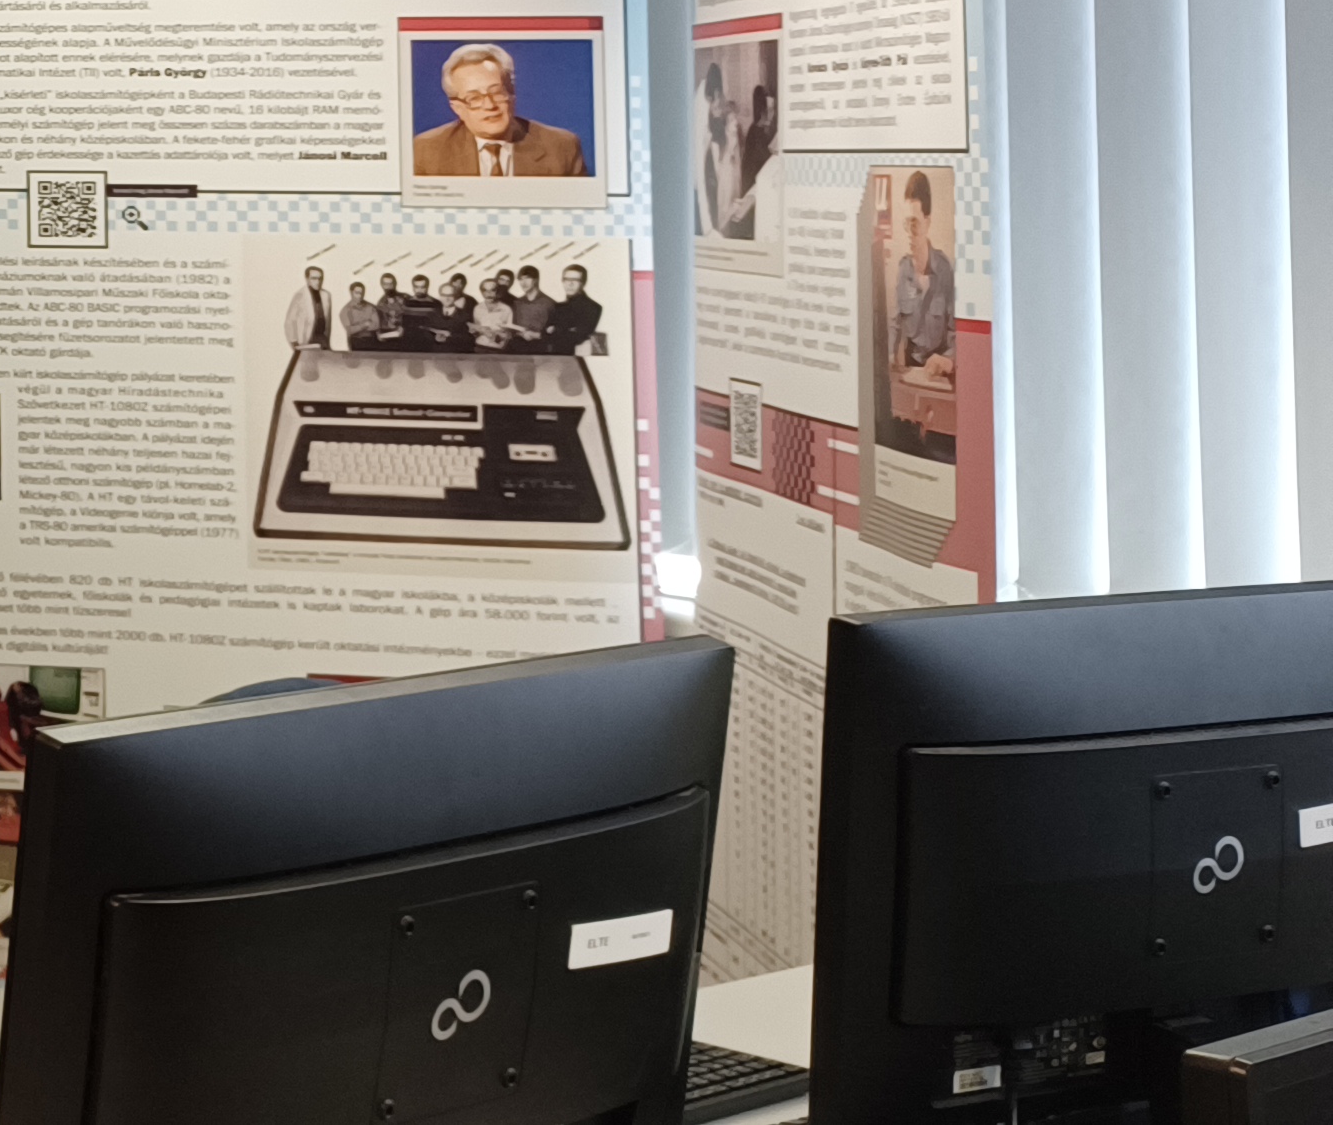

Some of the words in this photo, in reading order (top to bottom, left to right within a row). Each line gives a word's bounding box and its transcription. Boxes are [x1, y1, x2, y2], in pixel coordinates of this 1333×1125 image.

[49, 1, 61, 10] és
[302, 23, 315, 31] az
[367, 90, 381, 99] és
[26, 104, 46, 116] cég
[146, 106, 165, 116] egy
[249, 104, 263, 114] 16
[312, 105, 339, 114] RAM
